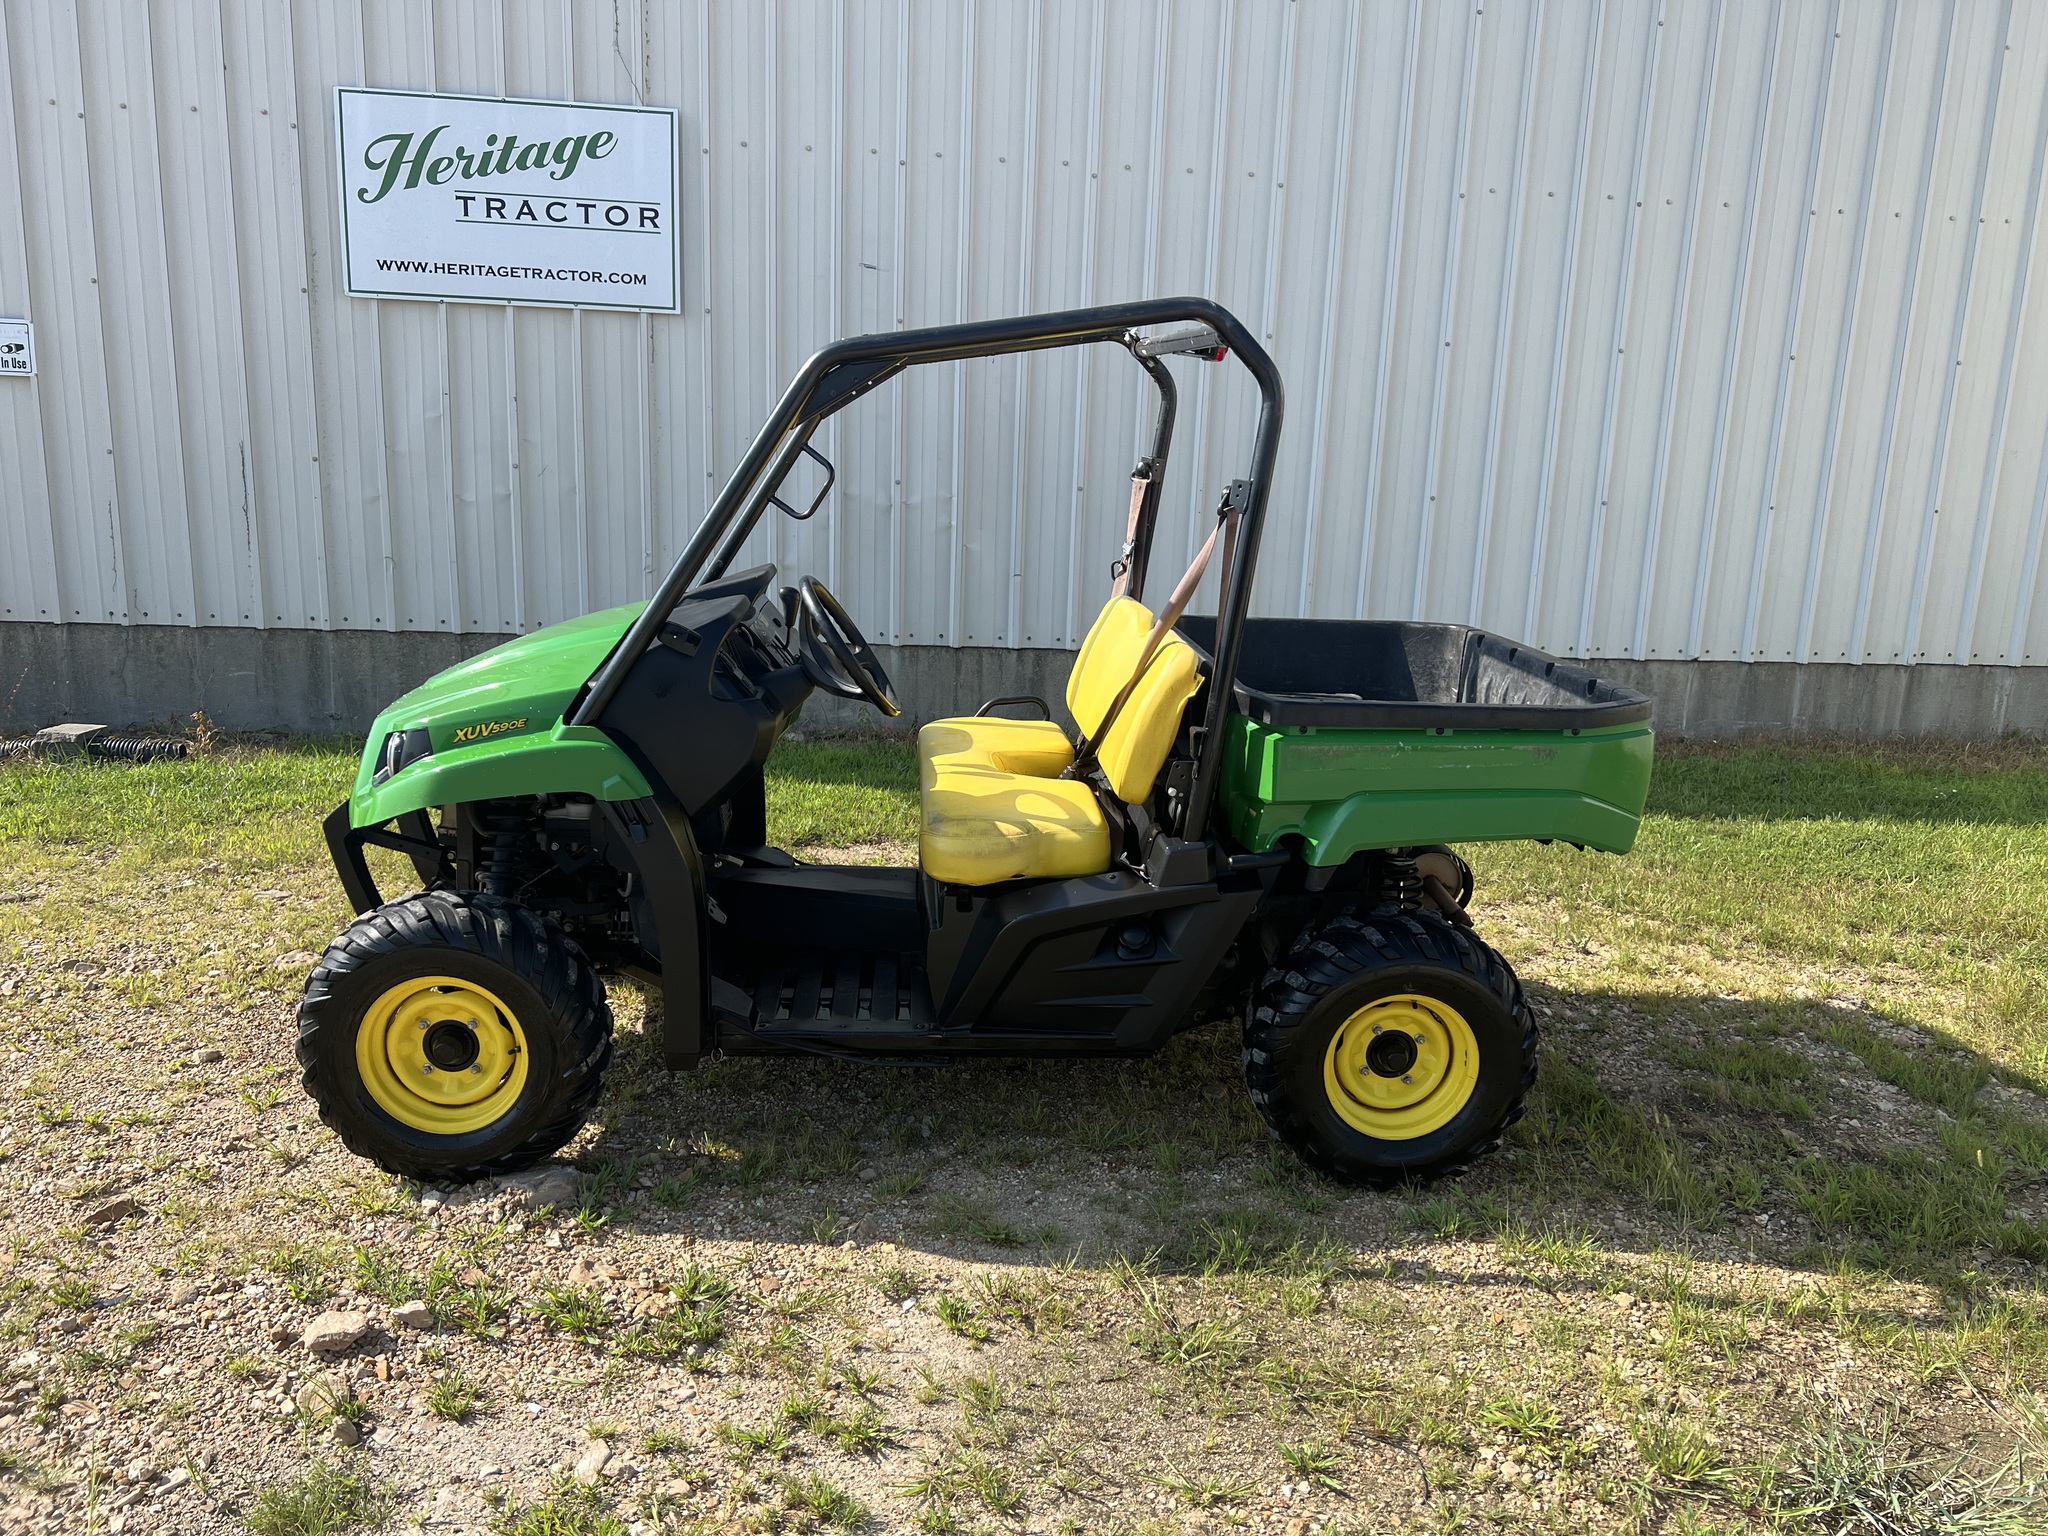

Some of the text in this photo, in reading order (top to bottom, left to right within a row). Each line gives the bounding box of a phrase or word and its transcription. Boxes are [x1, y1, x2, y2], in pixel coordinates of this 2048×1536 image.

[357, 125, 618, 203] Heritage
[455, 195, 660, 229] TRACTOR
[376, 259, 647, 286] WWW.HERITAGETRACTOR.COM
[1, 357, 27, 369] In Use
[453, 718, 528, 743] XUV590E
